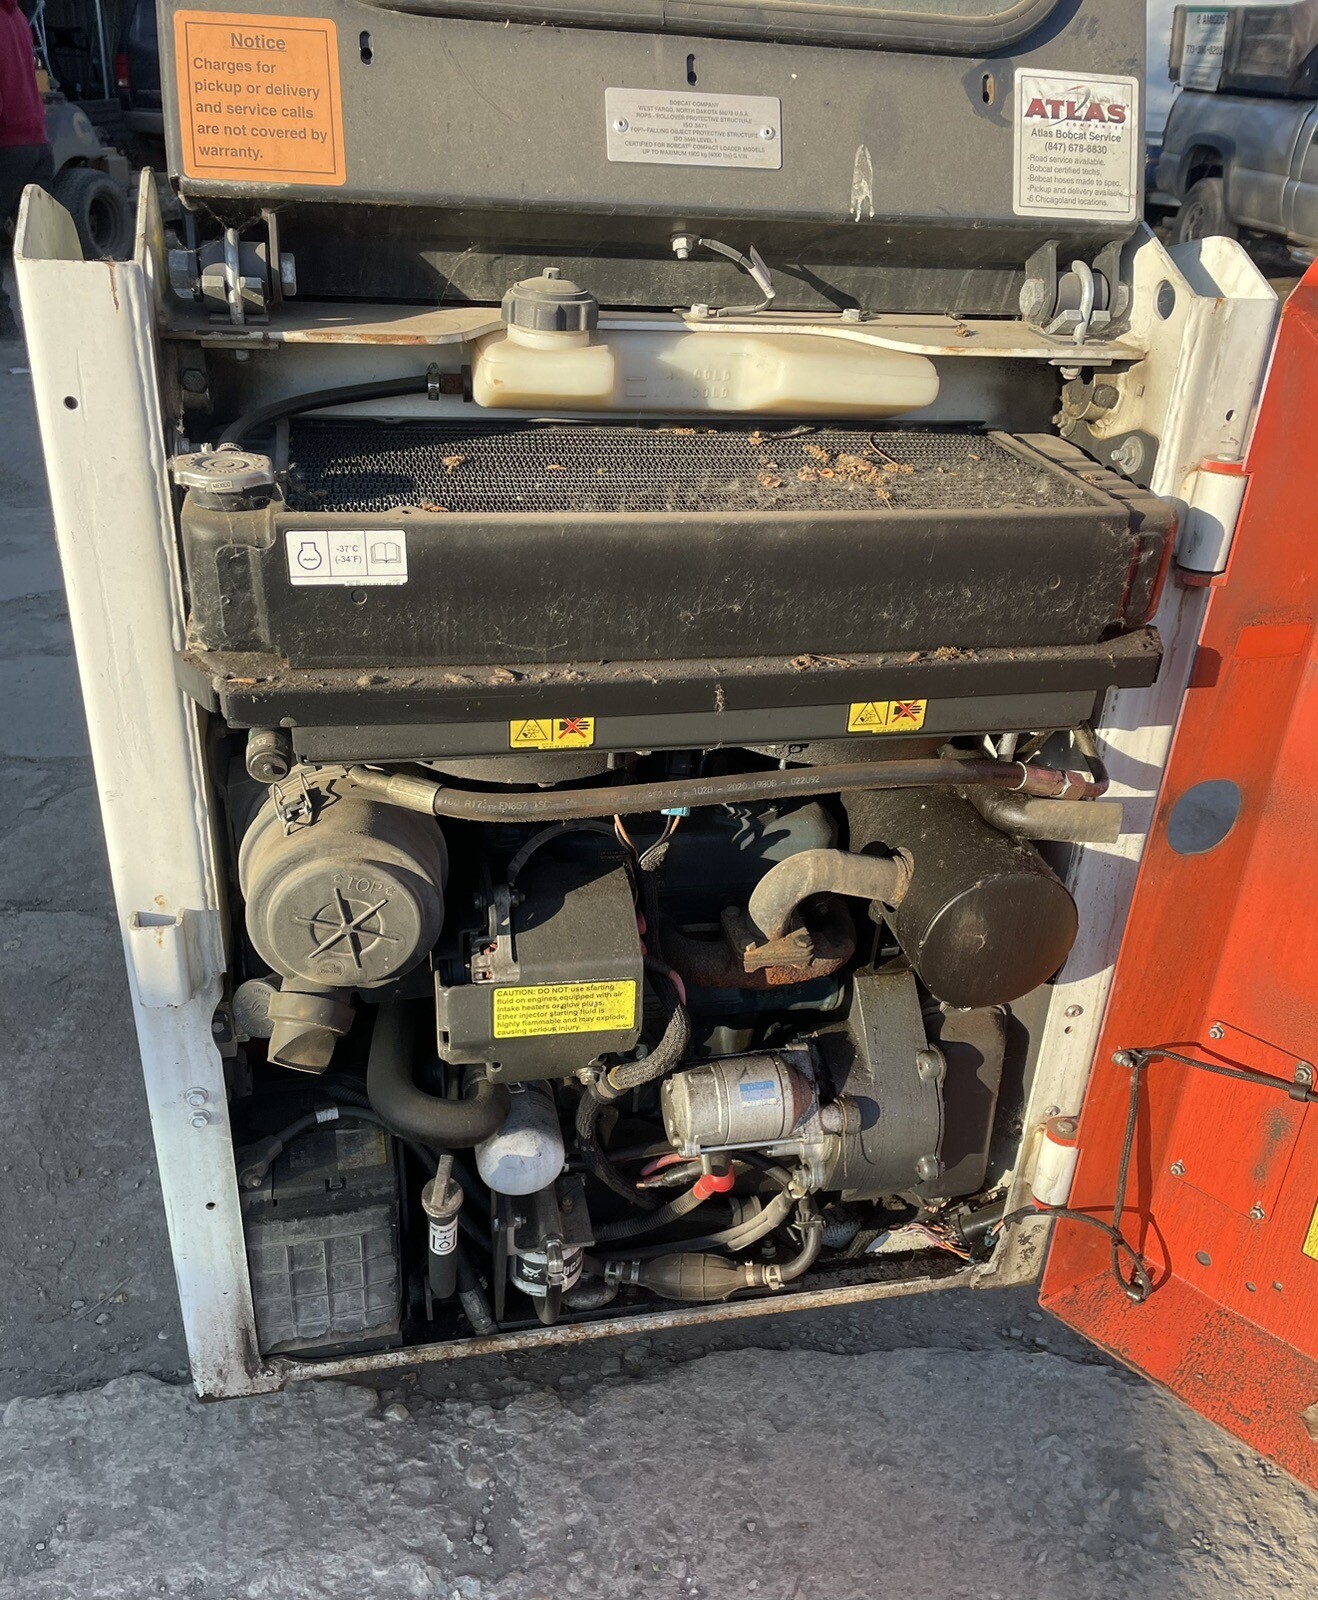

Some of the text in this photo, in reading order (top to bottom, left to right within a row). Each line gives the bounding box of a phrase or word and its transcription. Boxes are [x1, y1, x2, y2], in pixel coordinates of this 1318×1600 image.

[230, 32, 286, 50] Notice
[193, 57, 276, 74] Charges for
[194, 80, 320, 100] pickup or delivery
[196, 102, 313, 118] and service calls
[1024, 98, 1126, 124] ATLAS
[198, 124, 327, 143] are not covered by
[1031, 128, 1121, 142] Atlas Bobcat Service
[198, 145, 263, 161] warranty.
[1045, 142, 1107, 154] (847) 678-8830
[1050, 156, 1072, 164] service
[1074, 157, 1106, 166] available.
[1054, 166, 1080, 174] certified
[1082, 168, 1102, 176] techs.
[1054, 176, 1074, 185] hoses
[1068, 188, 1093, 196] delivery
[1035, 196, 1076, 206] Chicagoland
[1078, 198, 1108, 206] locations.
[212, 481, 231, 490] MEXICO
[586, 984, 615, 992] starting
[559, 992, 594, 1002] equipped
[497, 1004, 520, 1012] intake
[519, 1011, 547, 1020] injector
[550, 1009, 578, 1017] starting
